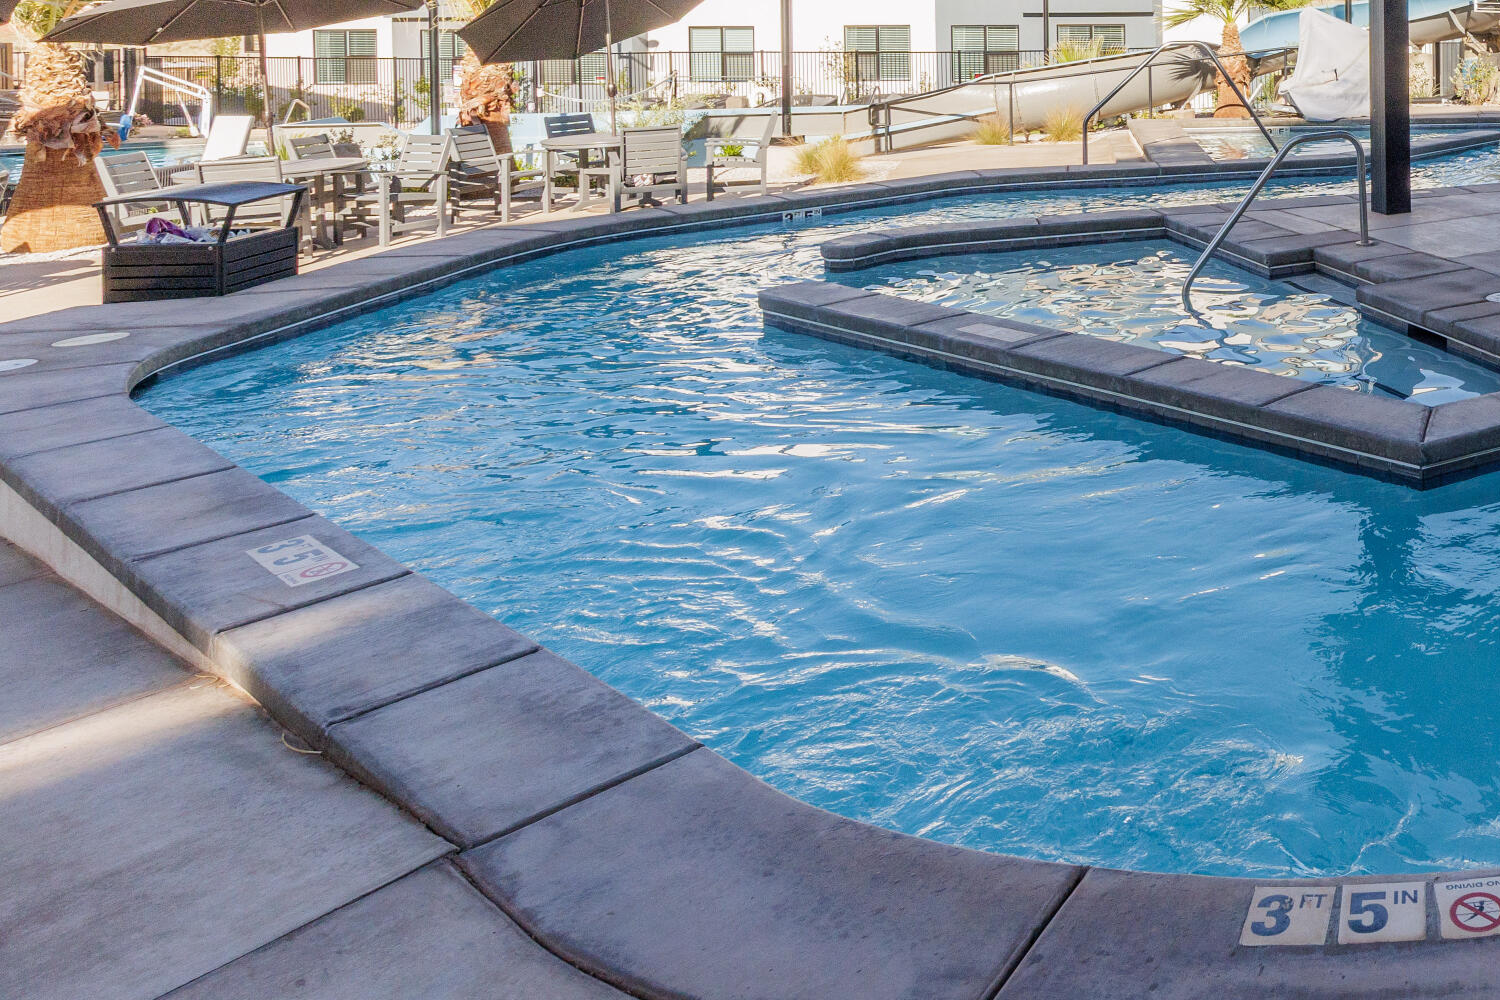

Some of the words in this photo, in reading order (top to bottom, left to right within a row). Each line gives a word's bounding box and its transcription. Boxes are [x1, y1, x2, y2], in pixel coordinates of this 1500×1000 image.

[257, 538, 305, 554] 3
[273, 548, 324, 566] 5
[1445, 881, 1484, 891] DIVING
[1250, 894, 1294, 937] 3
[1299, 893, 1328, 909] FT
[1347, 891, 1389, 934] 5
[1393, 889, 1419, 905] IN
